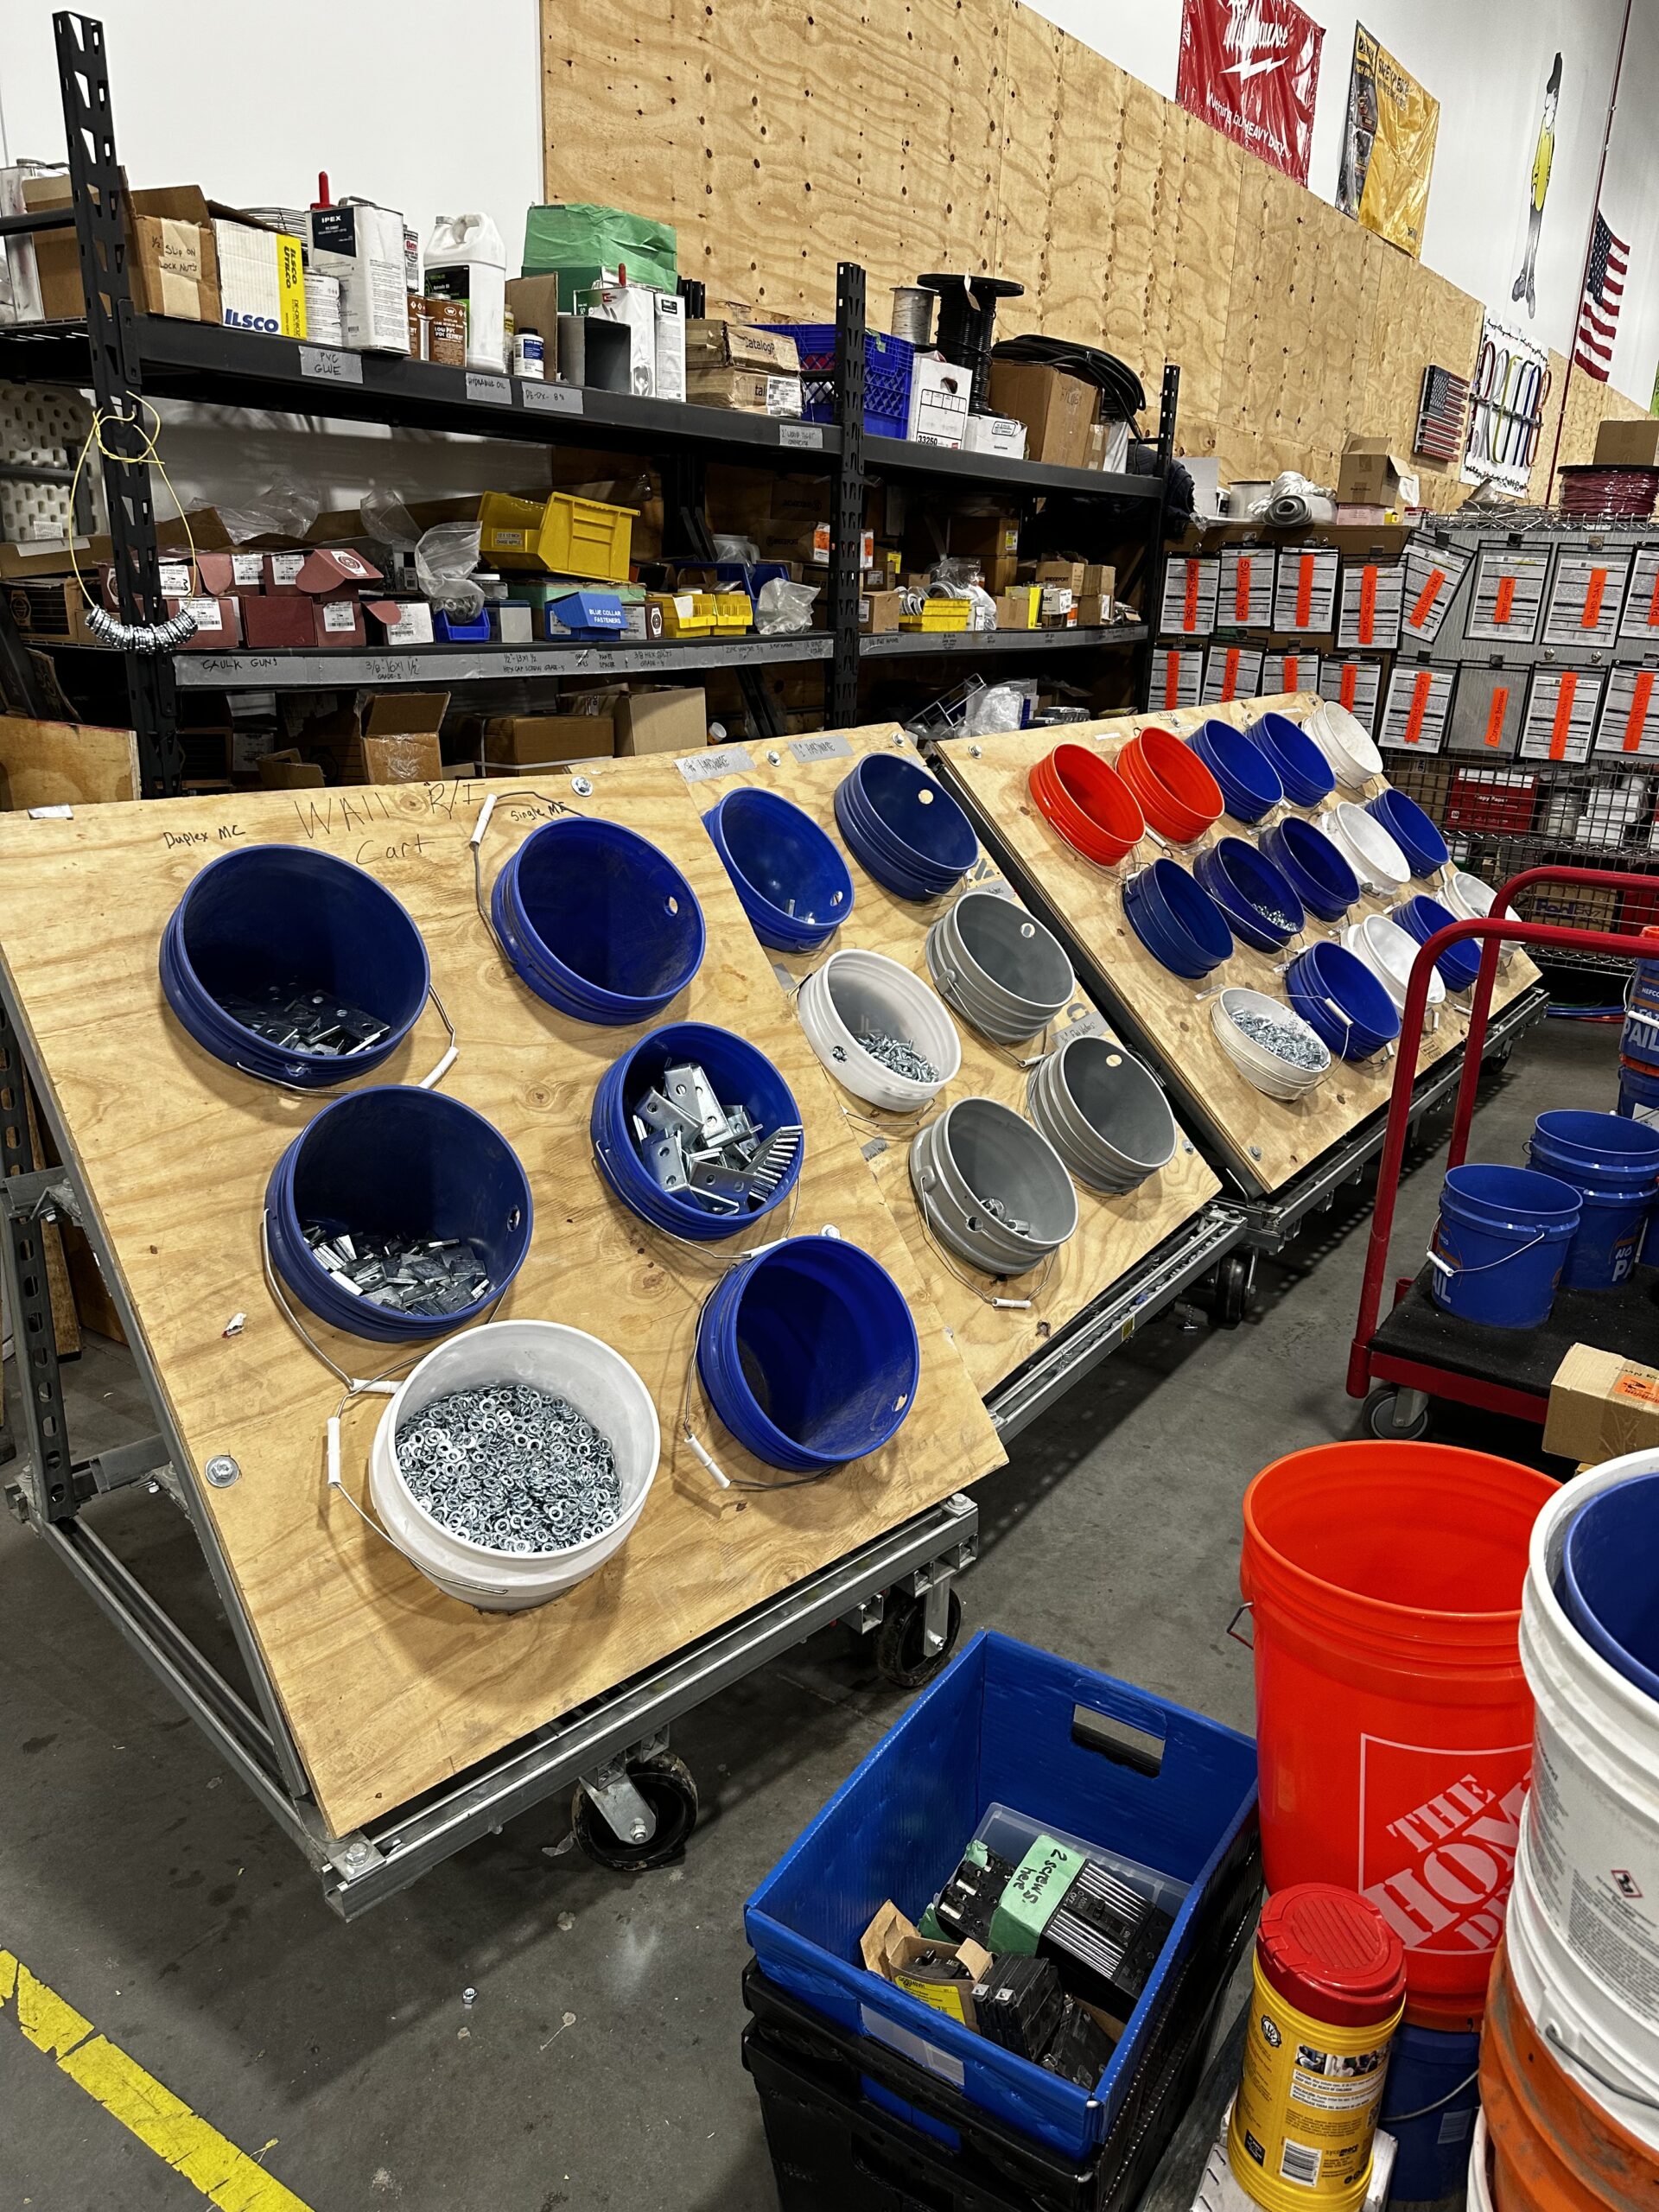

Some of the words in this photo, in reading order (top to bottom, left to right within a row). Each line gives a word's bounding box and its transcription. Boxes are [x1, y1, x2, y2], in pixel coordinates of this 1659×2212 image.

[187, 248, 196, 257] ON
[283, 245, 292, 289] UTILCO
[225, 308, 279, 333] ILSCO
[321, 352, 339, 364] PVC
[314, 364, 341, 376] GLUE
[918, 435, 938, 446] 33250
[1592, 581, 1602, 600] SAW
[1185, 604, 1194, 620] USE
[1414, 589, 1433, 620] BUILDING
[1587, 601, 1598, 620] BAND
[202, 659, 243, 670] CAULK
[1414, 677, 1428, 707] LIGHTING
[1631, 676, 1649, 725] ORIGINAL
[511, 808, 545, 822] Single
[163, 830, 208, 849] Duplex
[219, 825, 246, 840] MC
[356, 834, 435, 865] Cart
[1535, 898, 1602, 918] FedEx
[1624, 1018, 1659, 1052] PAIL
[1616, 1246, 1632, 1258] NO
[1386, 1774, 1497, 1853] THE
[1051, 1849, 1067, 1861] 2
[1362, 1768, 1532, 1947] HOM
[1013, 1867, 1037, 1892] here
